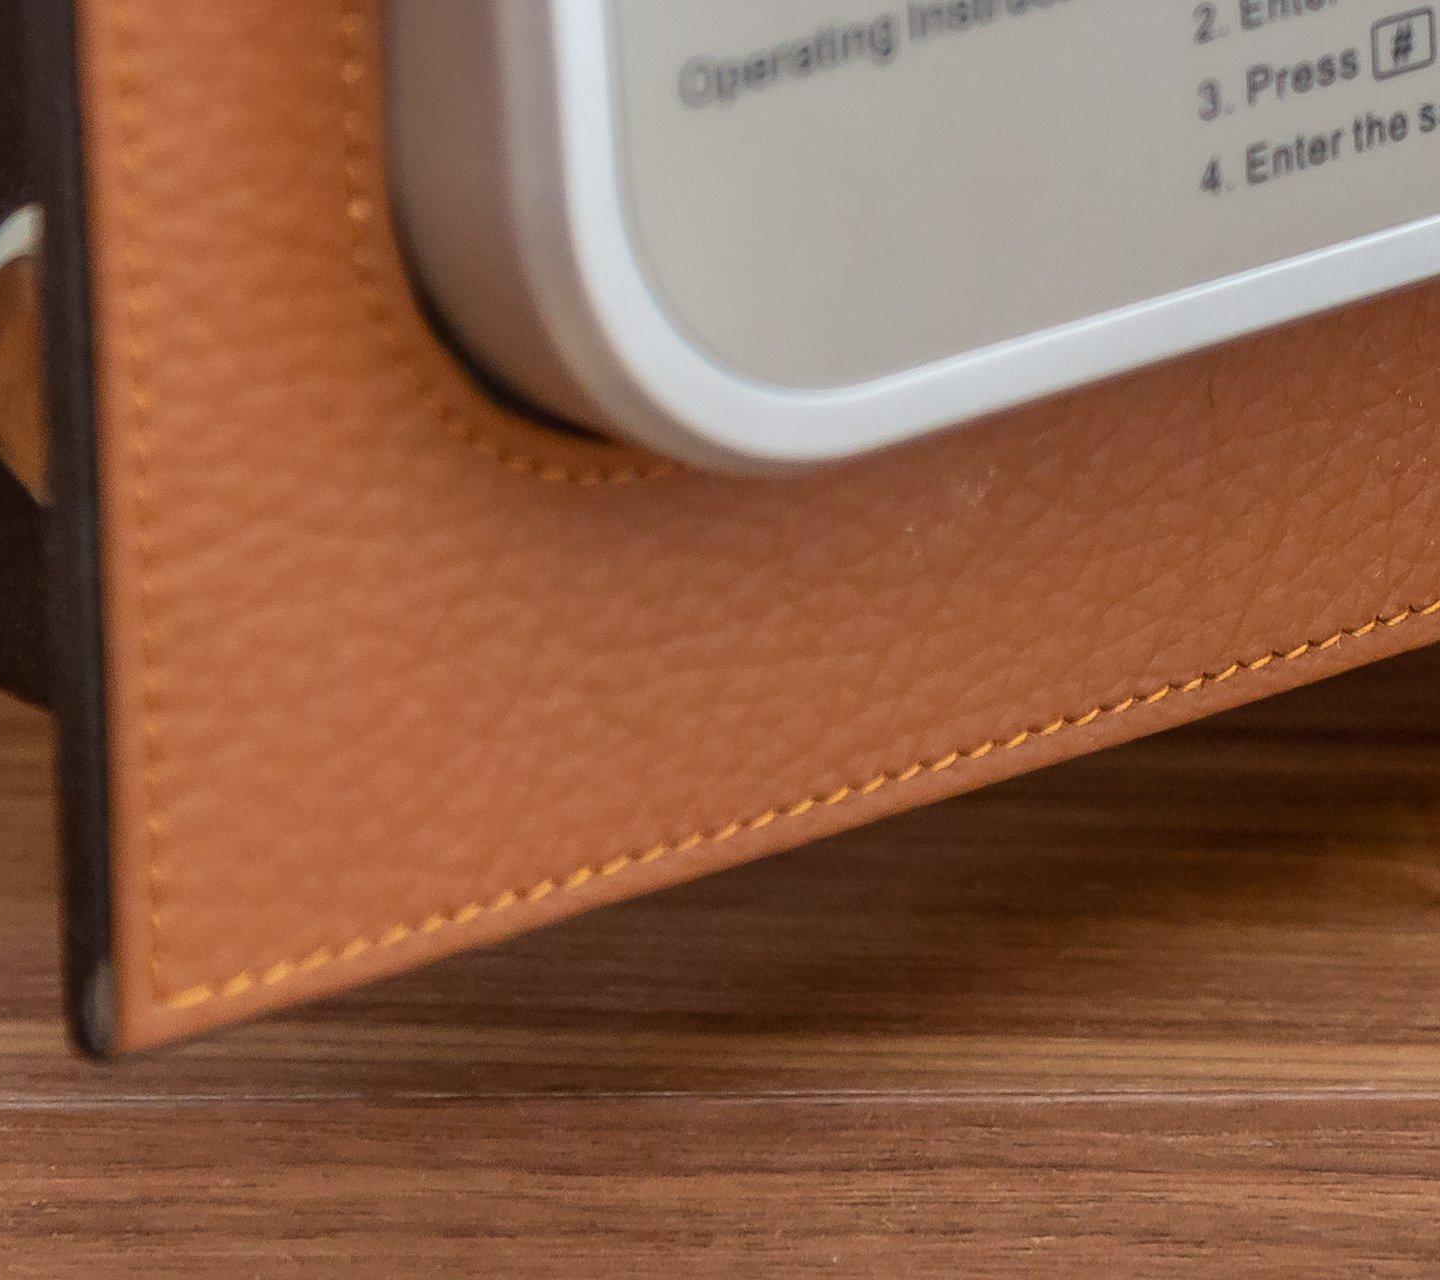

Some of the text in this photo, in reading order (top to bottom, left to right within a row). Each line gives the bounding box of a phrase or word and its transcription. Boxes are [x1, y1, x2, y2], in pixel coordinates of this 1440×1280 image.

[678, 13, 900, 110] Operating
[1190, 0, 1228, 45] 2.
[1196, 77, 1236, 121] 3.
[1245, 47, 1359, 106] Press
[1199, 154, 1236, 193] 4.
[1244, 128, 1344, 186] Enter
[1352, 110, 1410, 152] the
